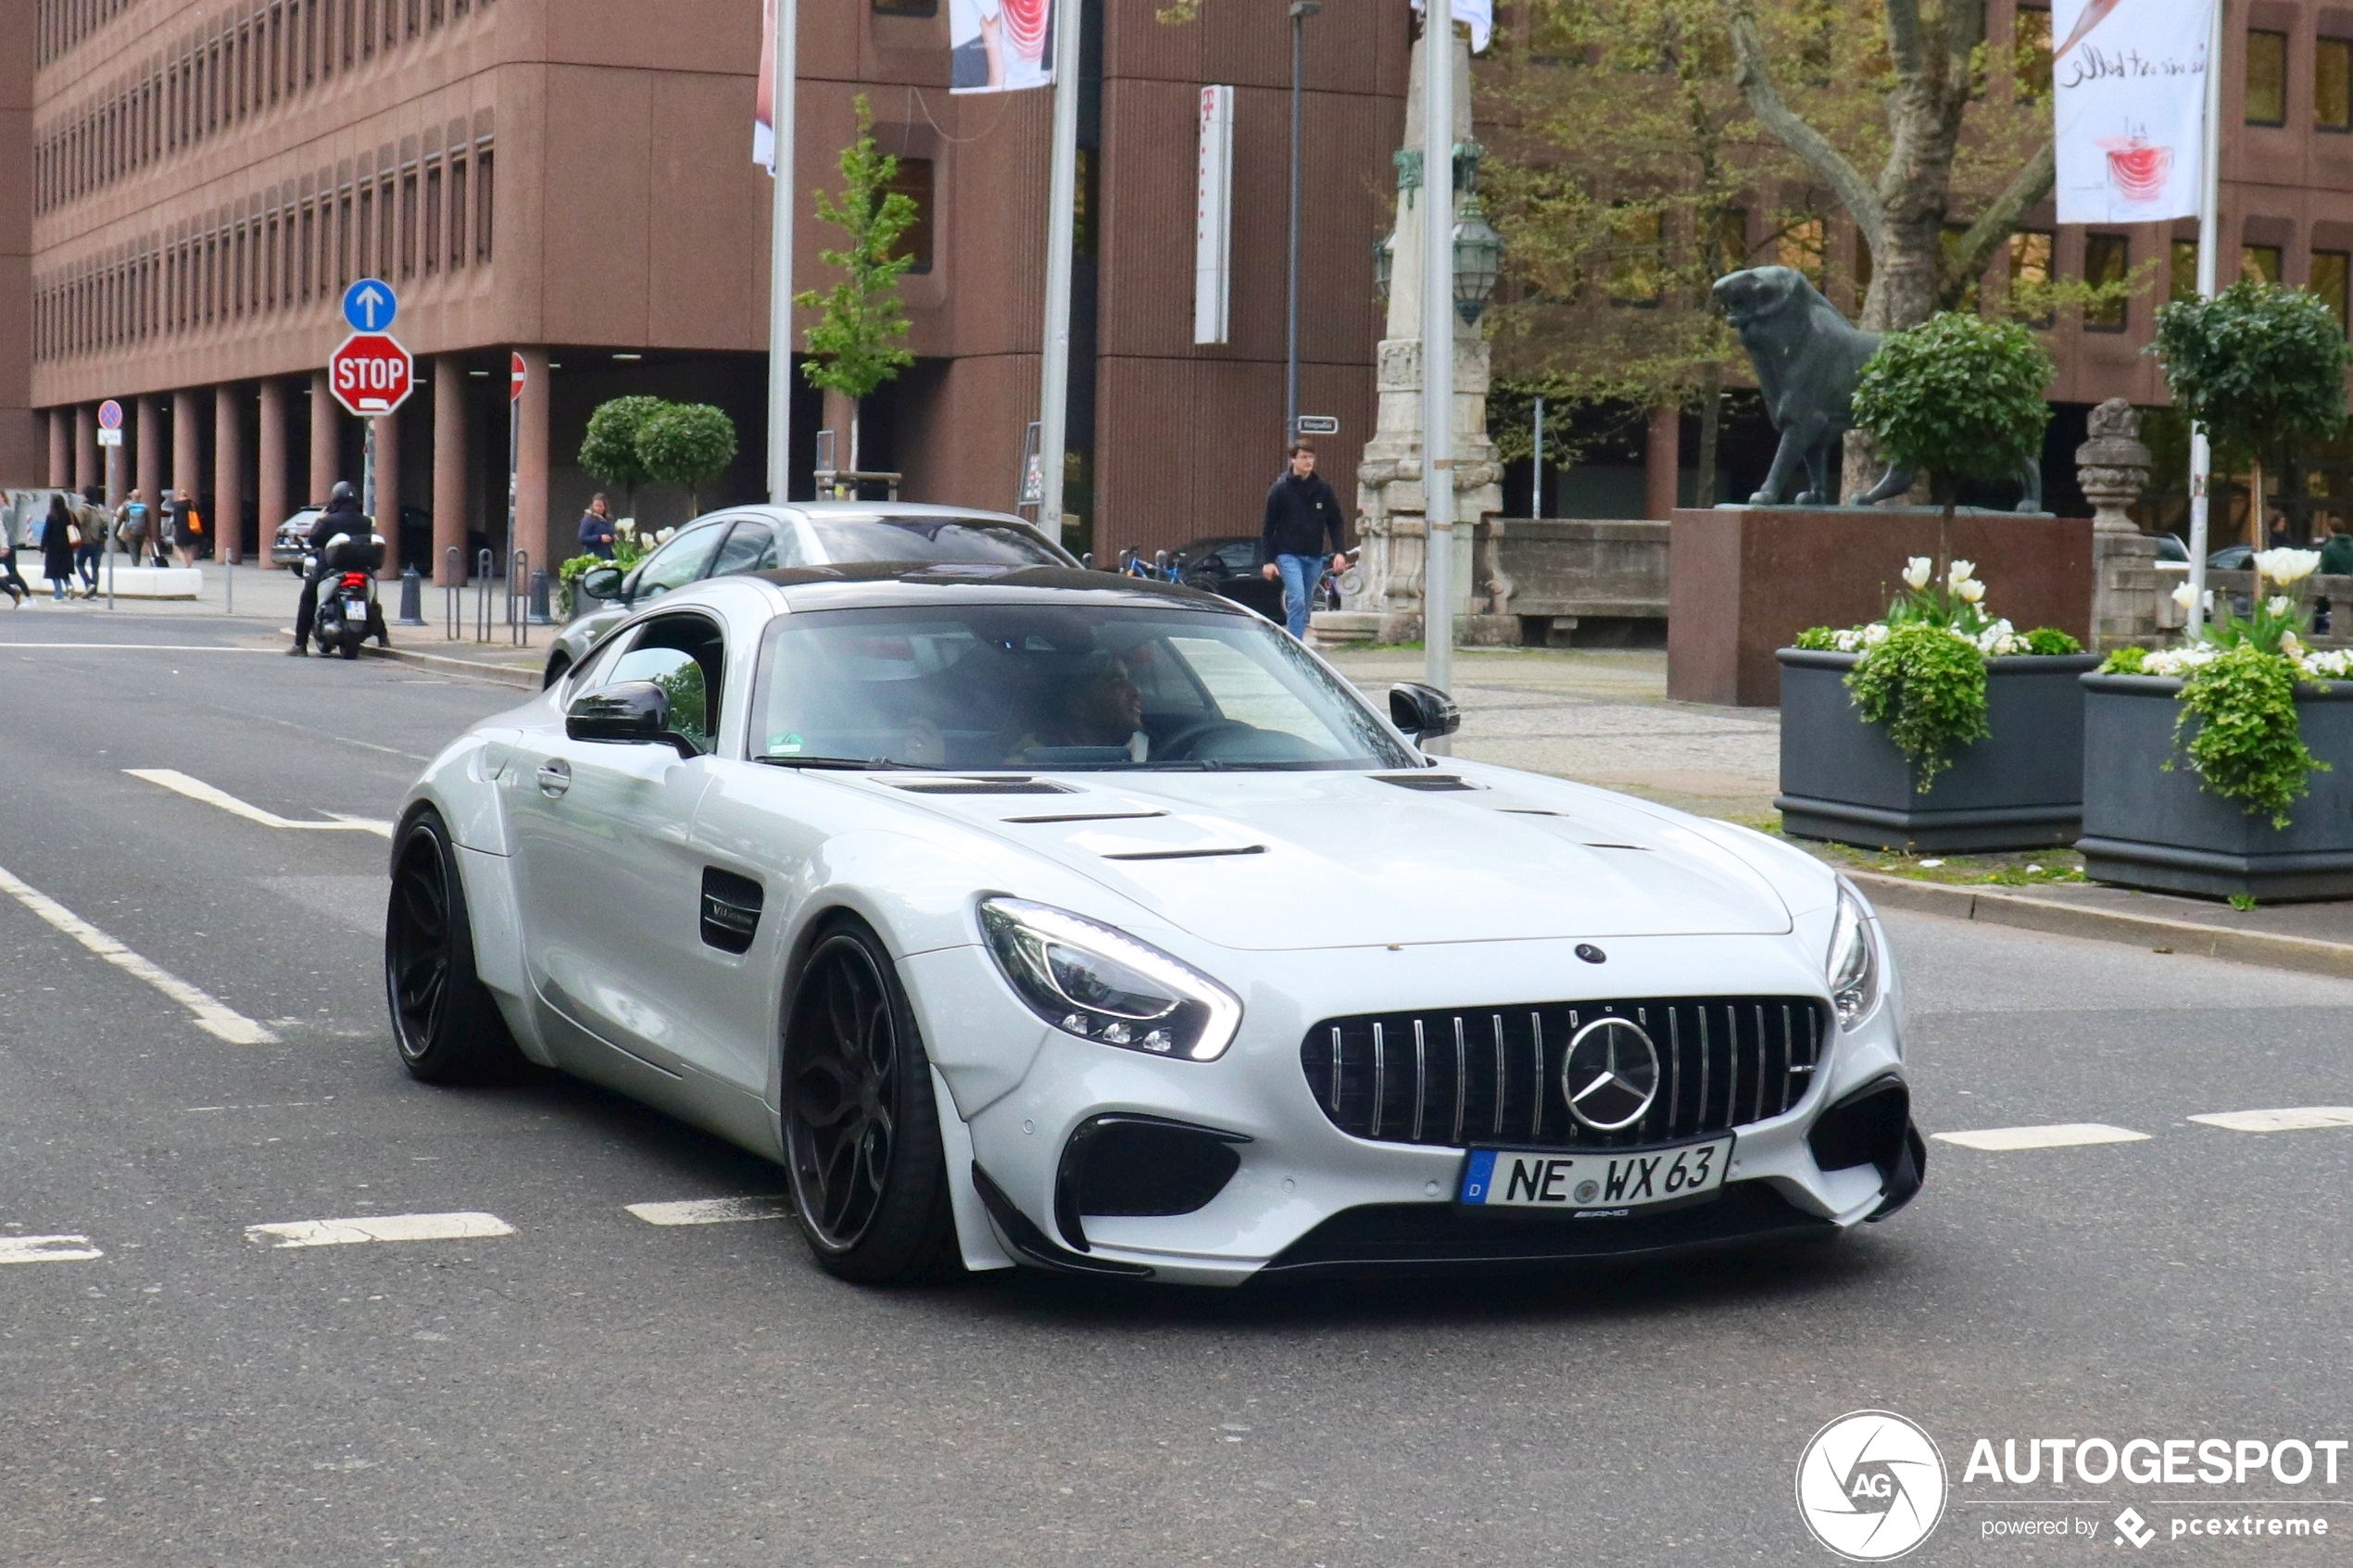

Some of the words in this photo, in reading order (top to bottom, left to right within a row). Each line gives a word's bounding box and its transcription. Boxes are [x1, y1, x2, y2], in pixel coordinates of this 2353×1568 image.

[338, 358, 405, 390] STOP
[1468, 1184, 1481, 1198] D
[1506, 1158, 1574, 1202] NE
[1604, 1155, 1663, 1201] WX
[1665, 1145, 1716, 1193] 63
